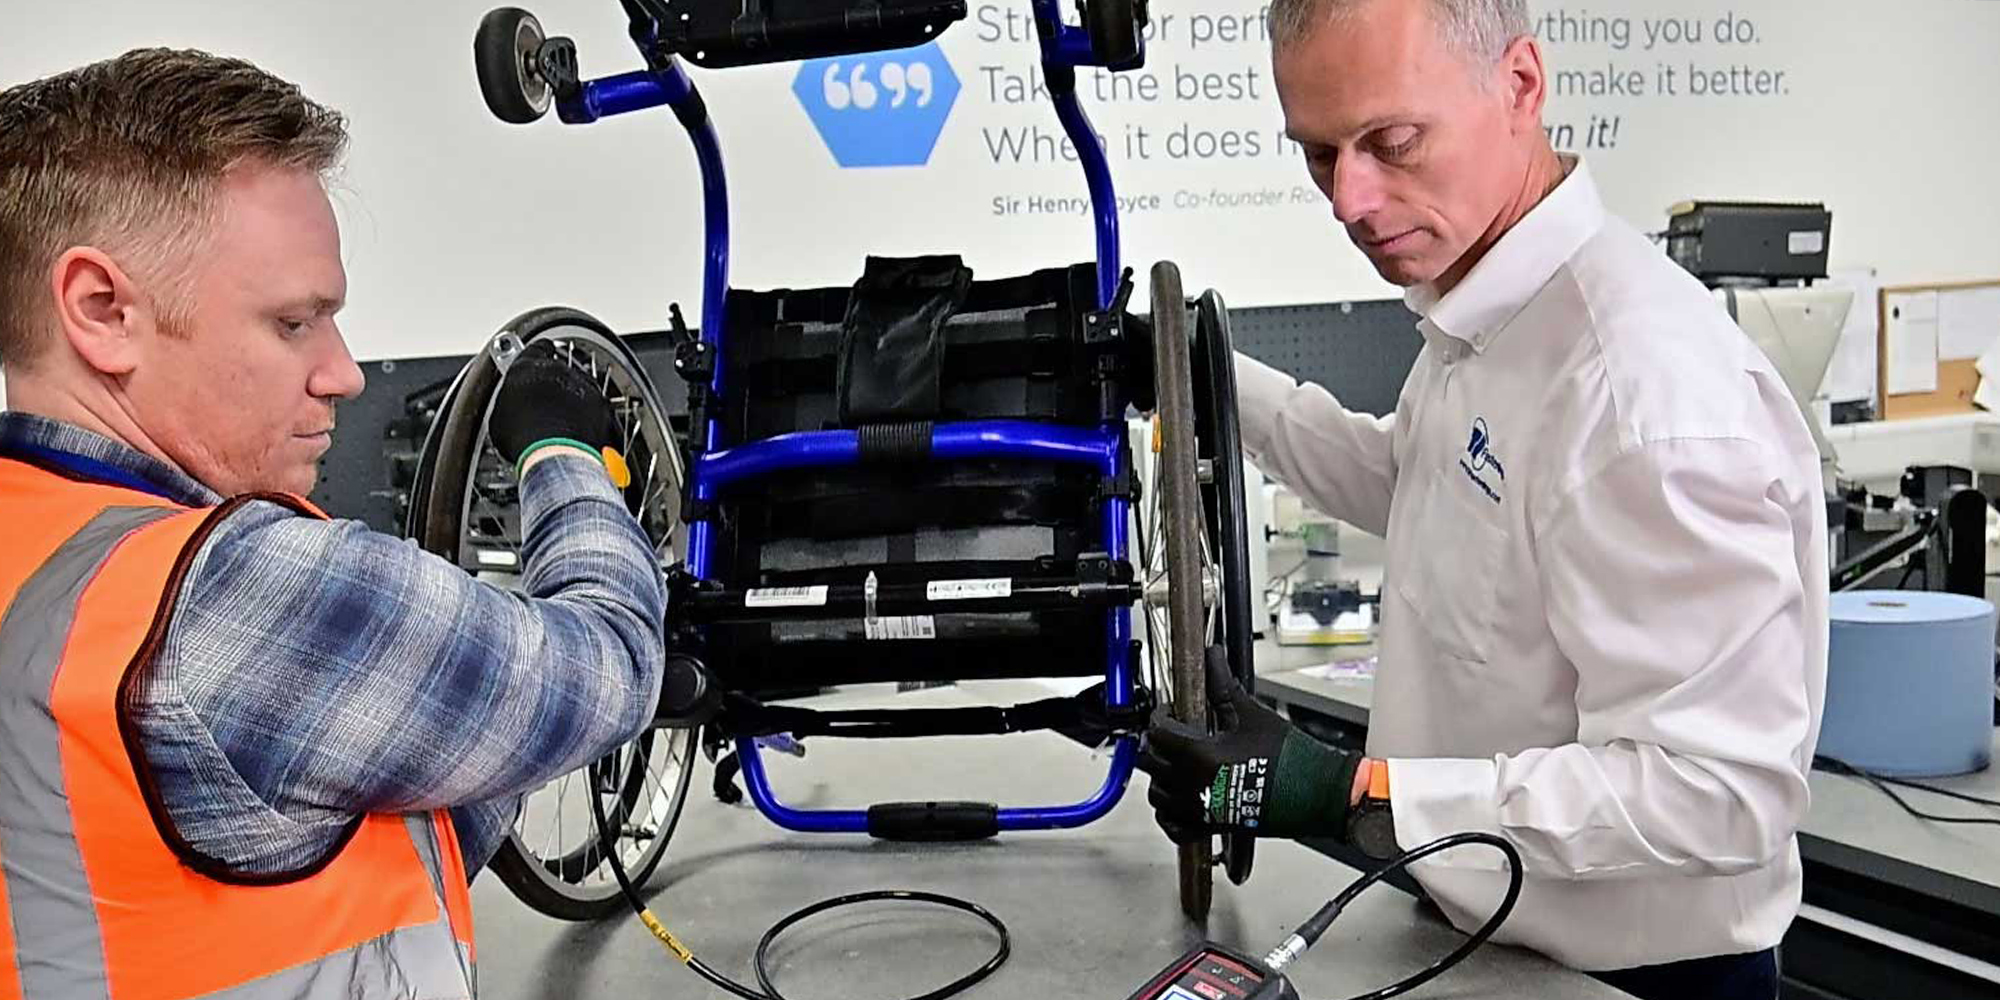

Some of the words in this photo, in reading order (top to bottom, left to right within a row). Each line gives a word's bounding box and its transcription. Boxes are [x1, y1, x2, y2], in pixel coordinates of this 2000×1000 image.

[977, 5, 1074, 42] Str
[1140, 14, 1174, 41] or
[1643, 19, 1701, 50] you
[1714, 10, 1761, 43] do.
[979, 65, 1051, 102] Tak
[1094, 66, 1159, 101] the
[1175, 63, 1259, 100] best
[1556, 63, 1645, 96] make
[1657, 63, 1676, 96] it
[1690, 62, 1790, 96] better.
[1125, 124, 1151, 160] it
[1166, 122, 1262, 159] does
[1586, 115, 1620, 148] it!
[992, 196, 1020, 215] Sir
[1028, 194, 1089, 216] Henry
[1116, 194, 1160, 214] oyce
[1173, 187, 1284, 209] Co-founder
